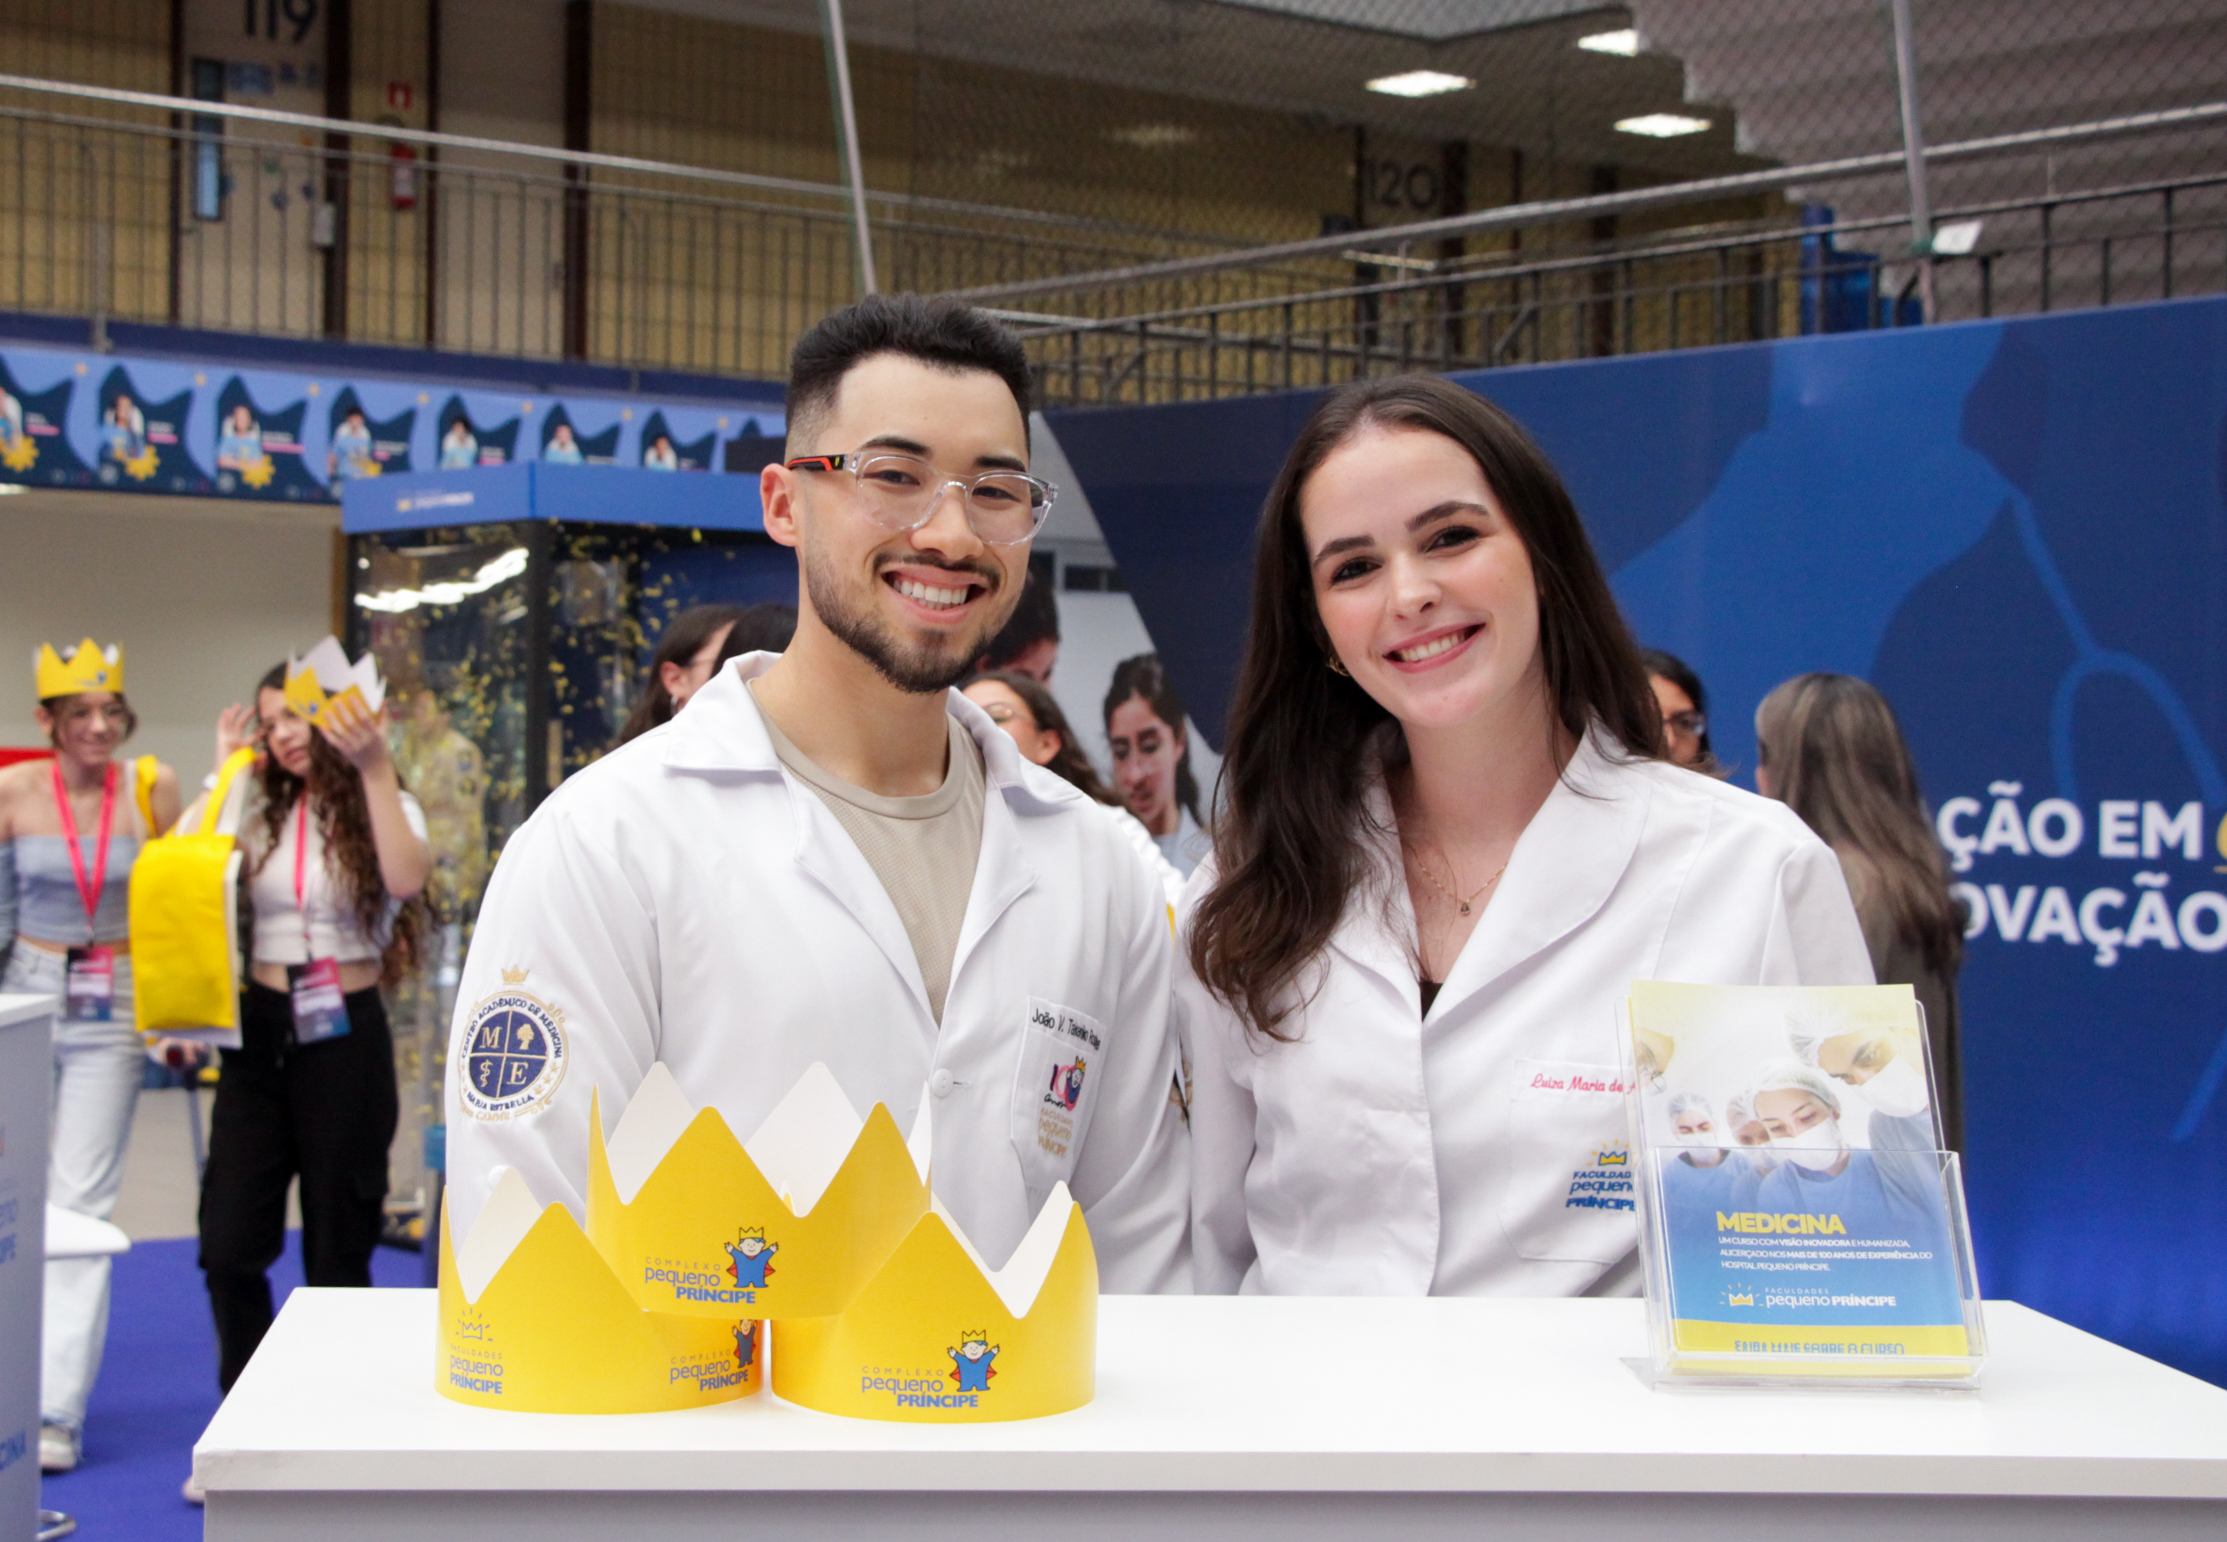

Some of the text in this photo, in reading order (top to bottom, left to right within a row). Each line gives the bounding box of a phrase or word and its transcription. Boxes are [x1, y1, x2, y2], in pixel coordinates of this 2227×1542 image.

[2099, 800, 2204, 860] EM
[1032, 1007, 1056, 1030] João
[461, 1020, 479, 1059] CENTRO
[528, 1003, 541, 1017] DE
[538, 1013, 564, 1059] MEDICINA
[1531, 1073, 1565, 1089] Luiza
[1567, 1075, 1606, 1092] Maria
[1609, 1078, 1623, 1092] de
[467, 1091, 535, 1111] MARIA ESTRELLA
[1569, 1180, 1634, 1195] pequen
[1716, 1211, 1847, 1235] MEDICINA
[1718, 1236, 1732, 1245] UM
[1731, 1236, 1759, 1246] CURSO
[1758, 1237, 1779, 1246] COM
[1779, 1236, 1803, 1247] VISÃO
[1803, 1239, 1851, 1248] INOVADORA
[1720, 1248, 1933, 1260] ALICERÇADO NOS MAIS DE 100 ANOS DE EXPERIÊNCIA DO
[645, 1257, 721, 1272] COMPLEXO
[1721, 1260, 1757, 1270] HOSPITAL
[1756, 1262, 1795, 1272] PEQUENO
[645, 1266, 721, 1288] pequeno
[676, 1285, 756, 1305] PRÍNCIPE
[1764, 1287, 1830, 1295] FACULDADES
[1765, 1293, 1897, 1309] pequeno PRÍNCIPE
[450, 1343, 503, 1360] FACULDADES
[670, 1349, 731, 1365] COMPLEXO
[450, 1355, 504, 1377] pequeno
[670, 1359, 731, 1385] pequeno
[862, 1366, 945, 1377] COMPLEXO
[450, 1371, 503, 1395] PRÍNCIPE
[699, 1368, 749, 1392] PRÍNCIPE
[862, 1376, 945, 1395] pequeno
[896, 1393, 980, 1409] PRÍNCIPE
